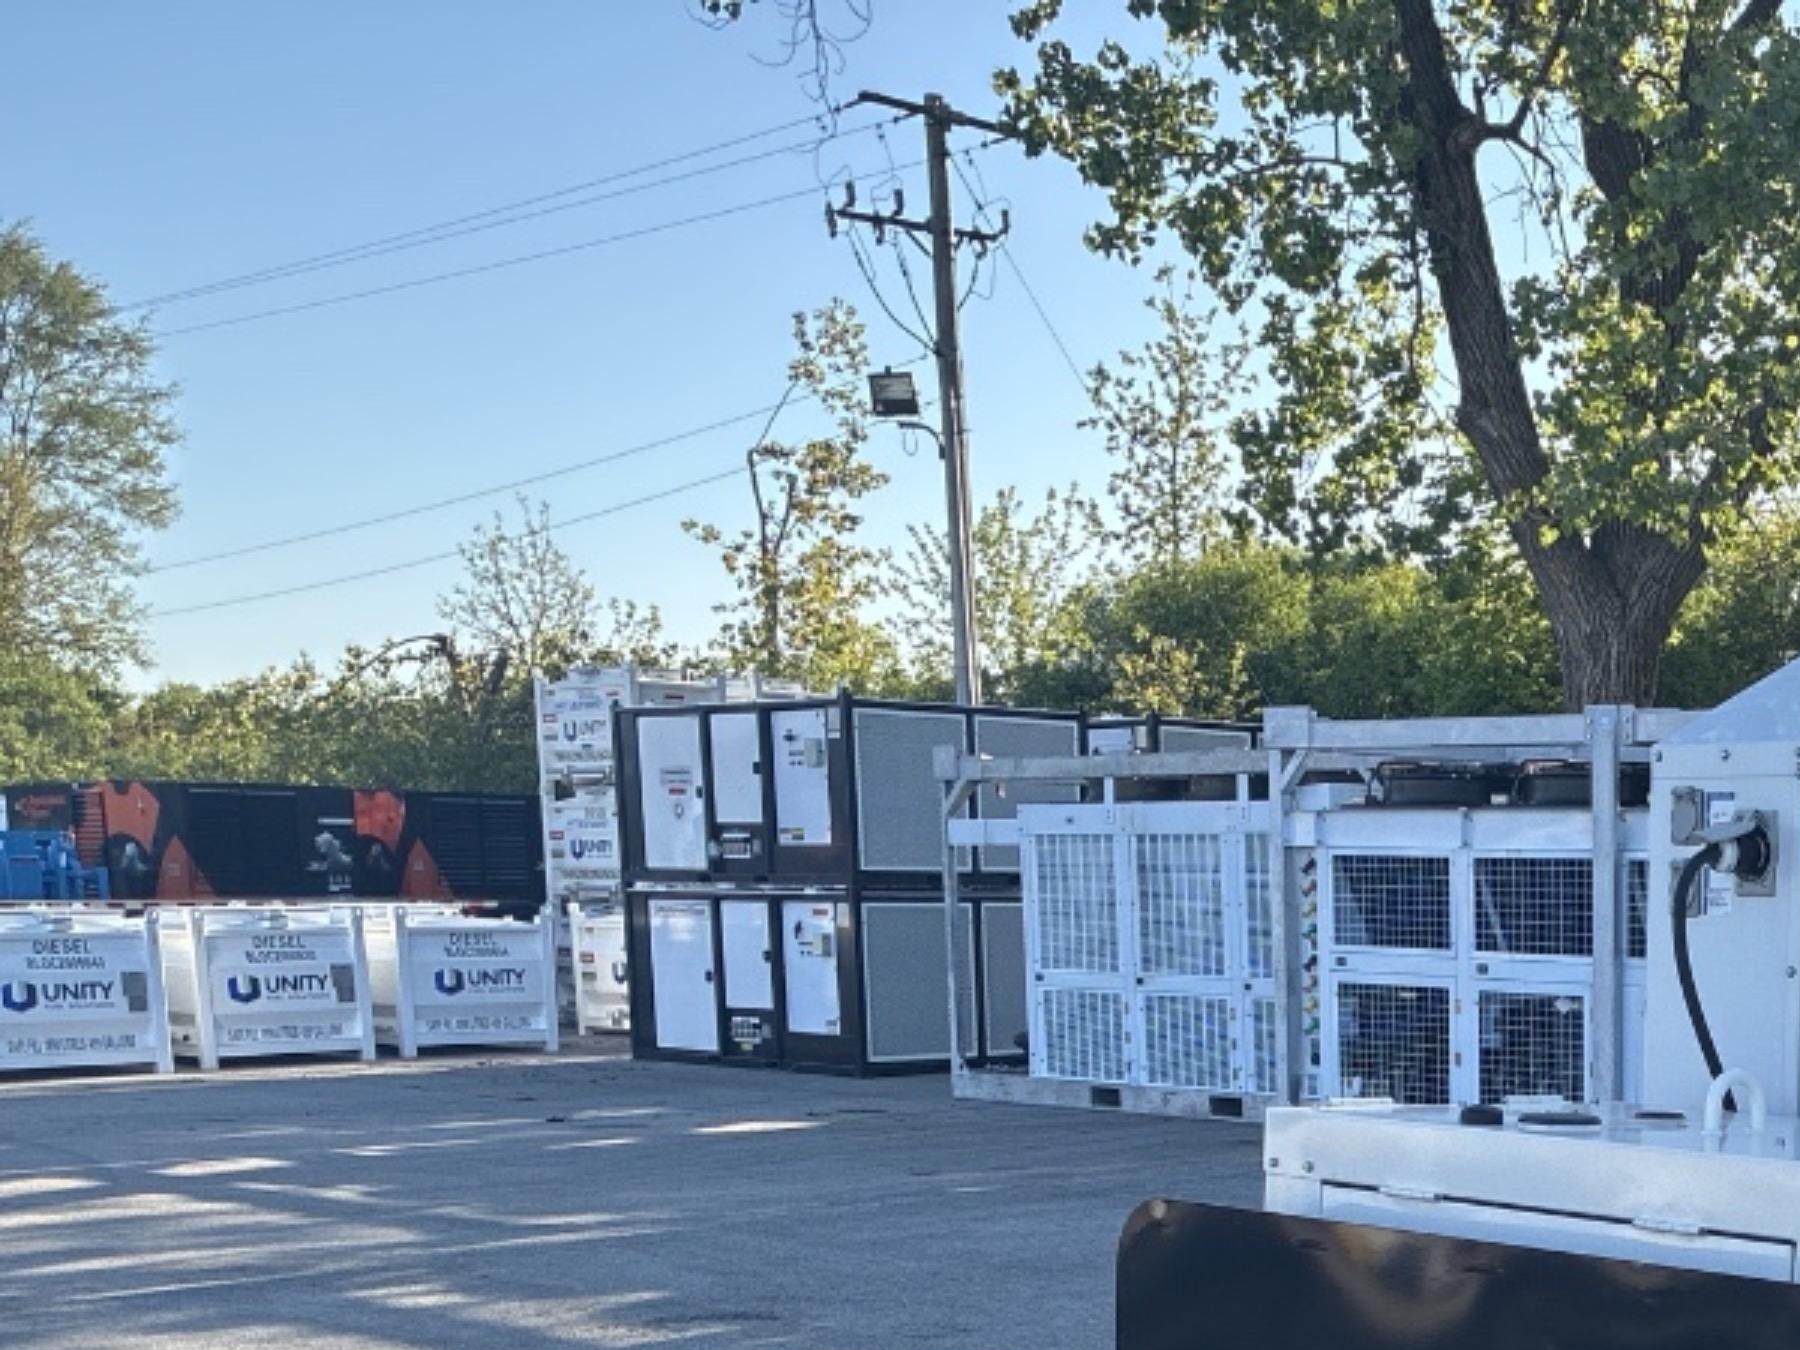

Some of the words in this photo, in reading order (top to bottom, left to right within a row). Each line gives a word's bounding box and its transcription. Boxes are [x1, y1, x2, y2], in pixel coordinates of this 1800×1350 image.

[32, 938, 91, 955] DIESEL
[252, 935, 307, 949] DIESEL
[450, 931, 497, 946] DIESEL
[265, 974, 328, 993] UNITY
[468, 968, 526, 985] UNITY
[42, 981, 114, 1001] UNITY
